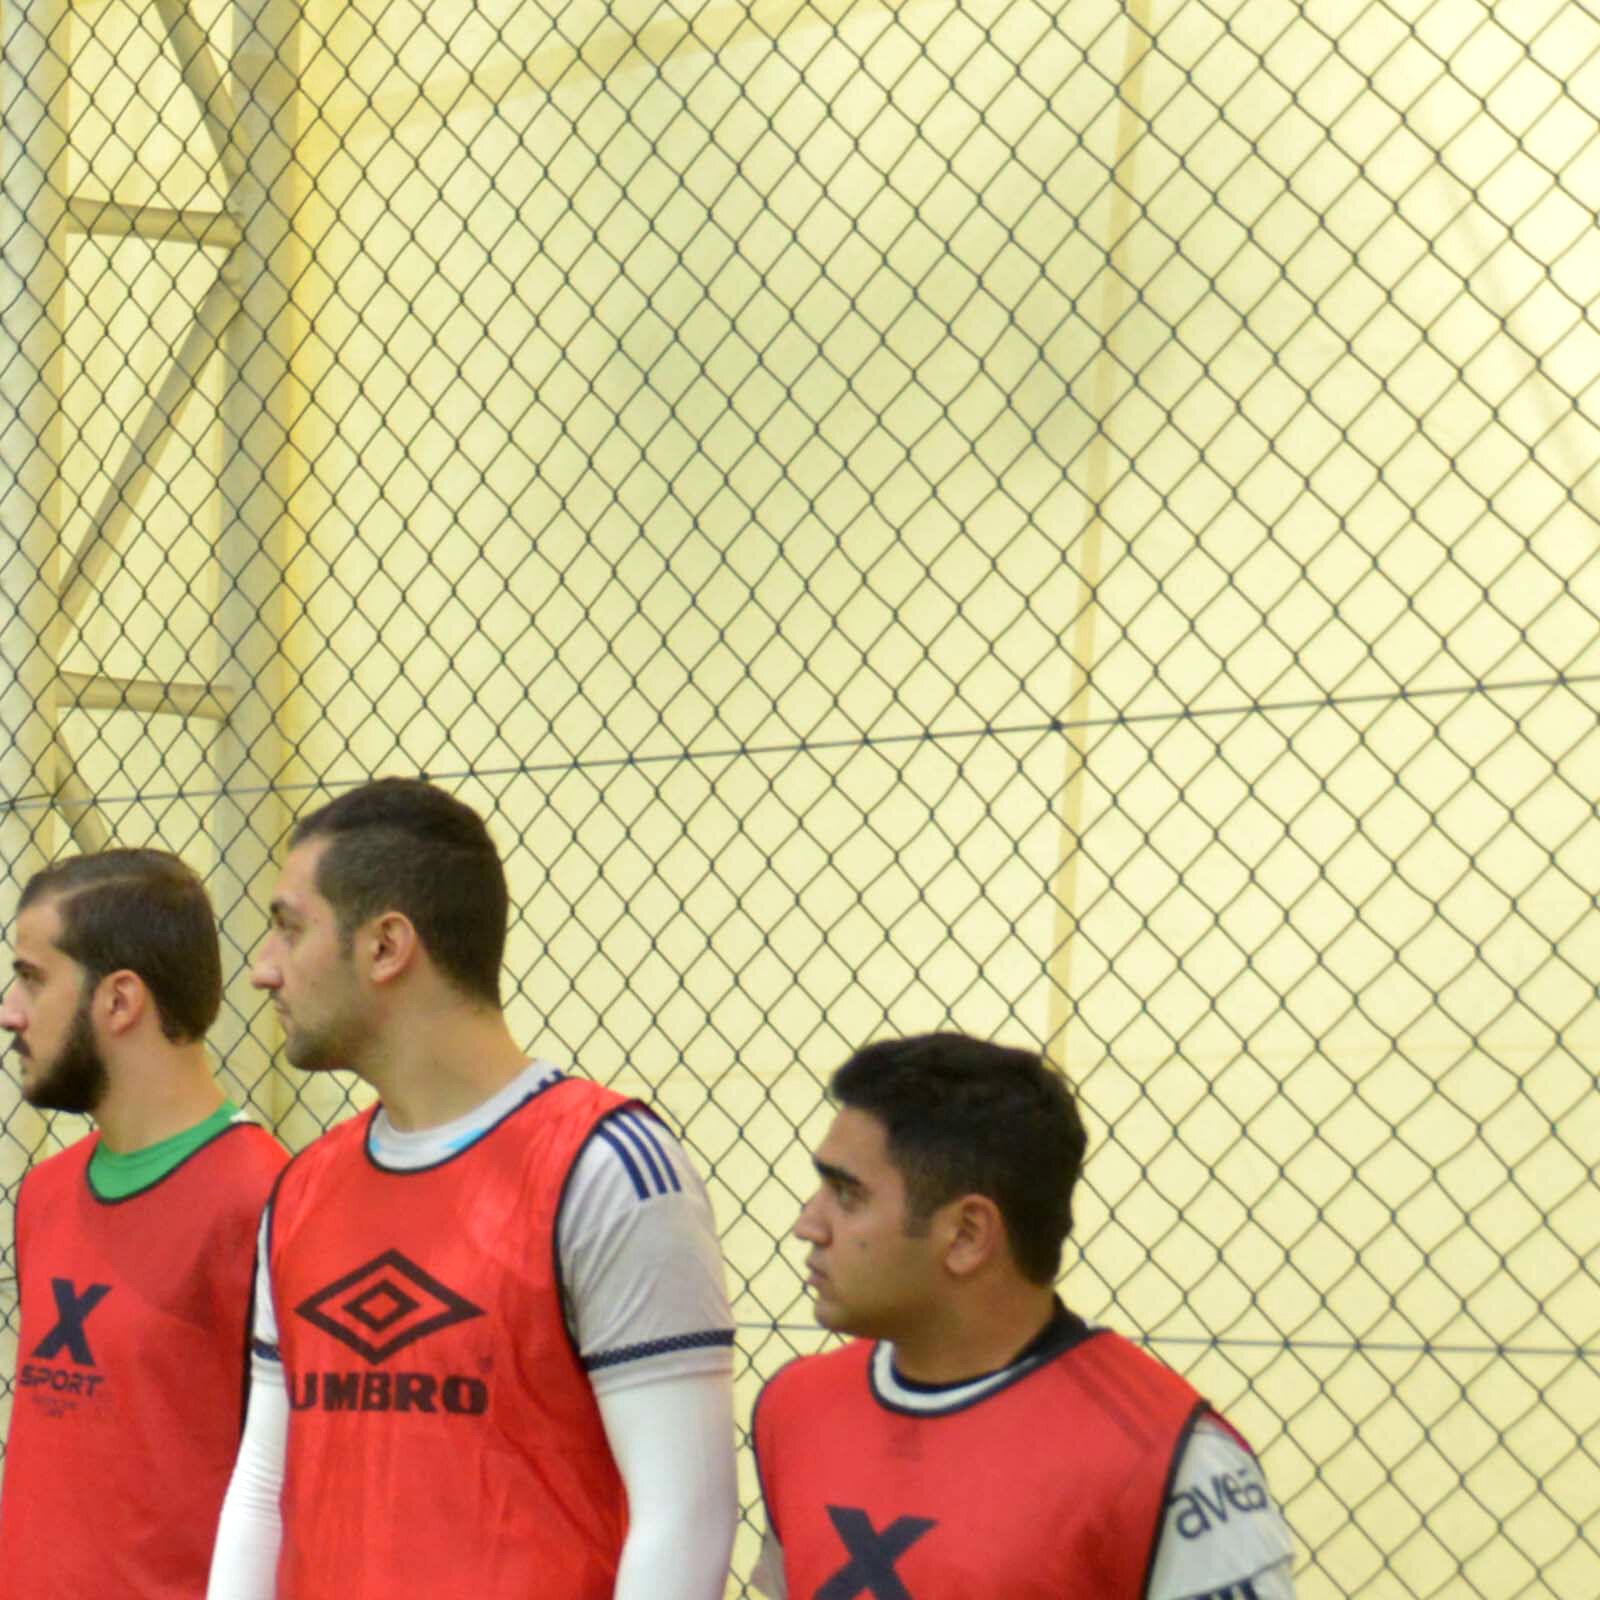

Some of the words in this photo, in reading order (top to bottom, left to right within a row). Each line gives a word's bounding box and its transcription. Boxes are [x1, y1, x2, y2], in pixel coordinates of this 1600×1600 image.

[32, 1277, 113, 1367] X
[21, 1364, 105, 1397] SPORT
[288, 1371, 488, 1416] UMBRO
